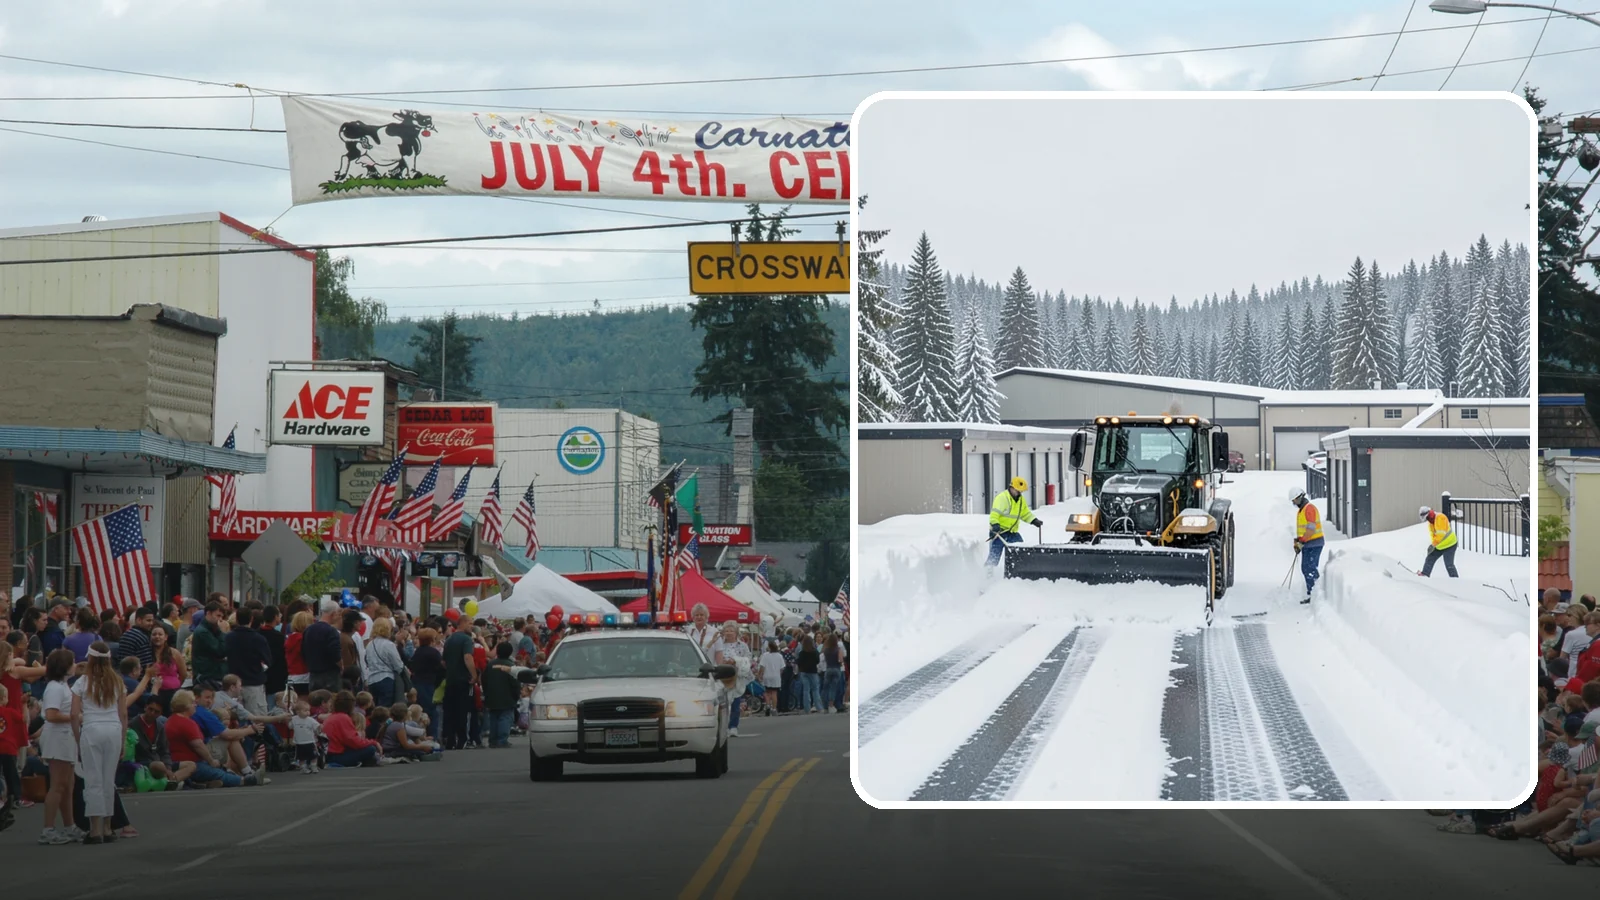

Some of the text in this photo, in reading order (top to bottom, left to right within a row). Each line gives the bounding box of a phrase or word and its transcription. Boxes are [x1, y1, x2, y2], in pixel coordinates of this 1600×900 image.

[481, 141, 605, 193] JULY
[632, 150, 747, 198] 4th.
[696, 254, 850, 280] CROSSWA
[282, 380, 374, 420] ACE
[405, 409, 485, 422] CEDAR LOG
[283, 421, 371, 436] Hardware
[95, 485, 124, 495] Vincent
[126, 486, 136, 495] de
[138, 486, 155, 495] Paul
[688, 526, 741, 535] CRNATION
[699, 535, 730, 543] GLASS
